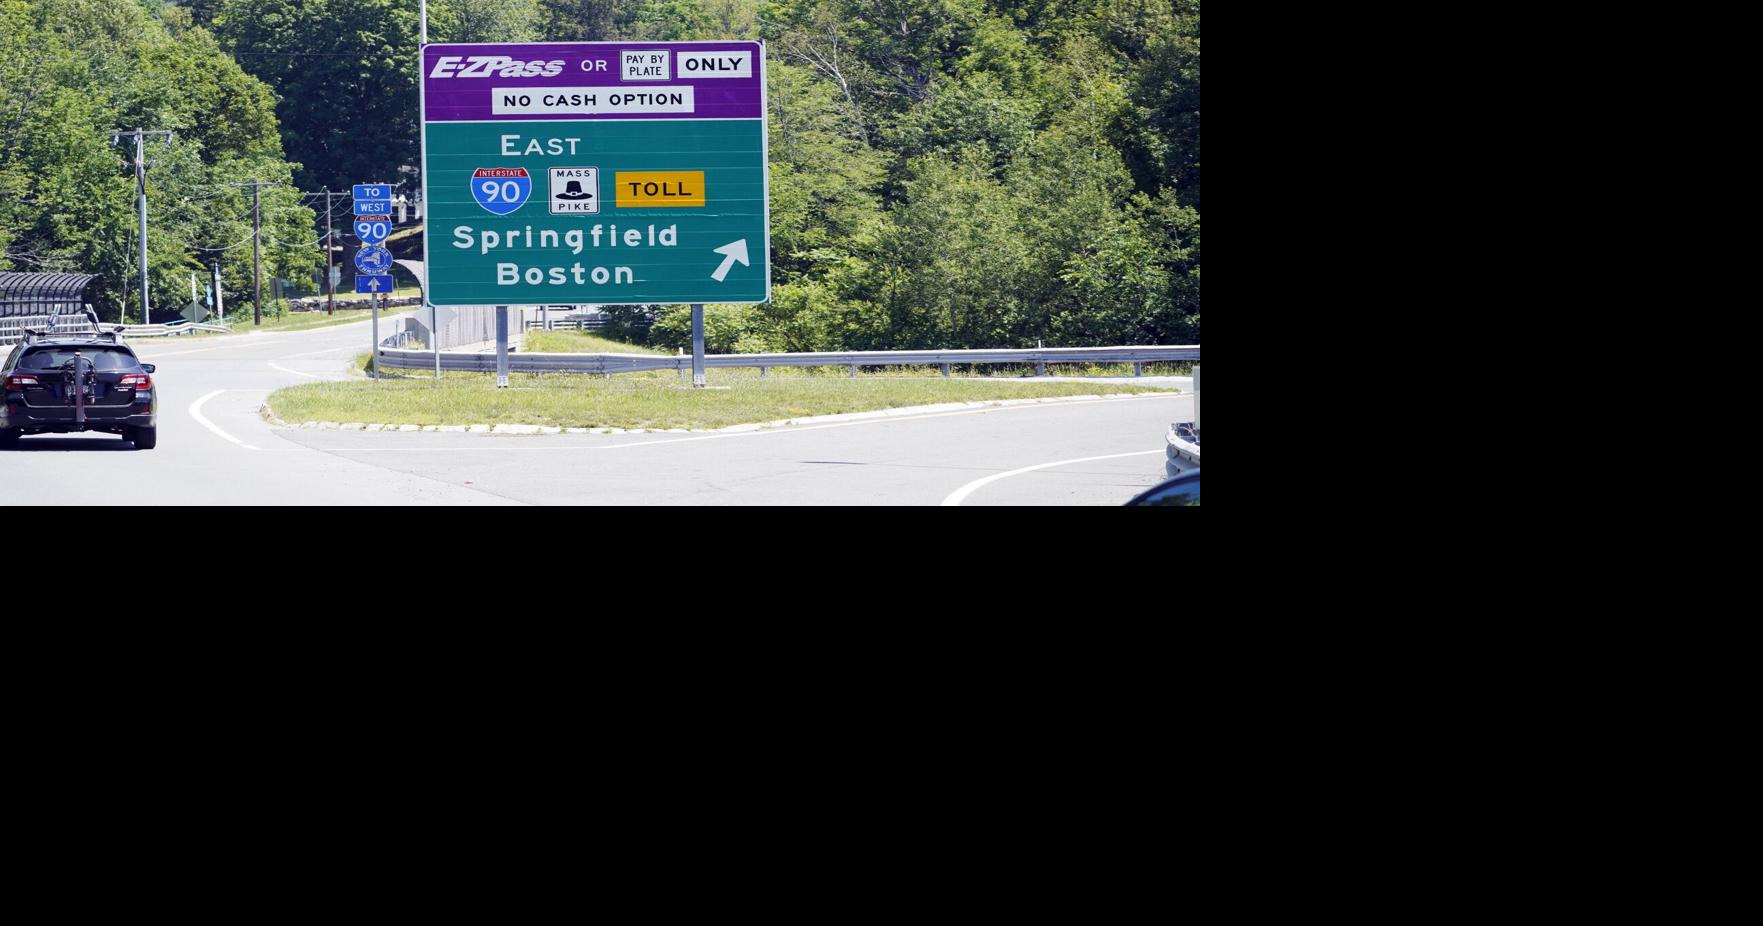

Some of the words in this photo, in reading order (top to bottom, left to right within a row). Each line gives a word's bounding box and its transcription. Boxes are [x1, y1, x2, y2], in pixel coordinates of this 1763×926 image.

[581, 59, 607, 72] OR
[626, 55, 645, 64] PAY
[650, 55, 664, 63] BY
[685, 57, 742, 72] ONLY
[629, 66, 662, 76] PLATE
[504, 95, 531, 107] NO
[543, 94, 596, 107] CASH
[609, 93, 683, 106] OPTION
[501, 134, 581, 156] EAST
[479, 169, 522, 177] INTERSTATE
[556, 169, 590, 178] MASS
[364, 187, 380, 197] TO
[481, 180, 520, 203] 90
[628, 182, 692, 196] TOLL
[360, 203, 385, 212] WEST
[558, 203, 590, 211] PIKE
[358, 222, 387, 239] 90
[452, 223, 678, 255] Springfield
[497, 262, 634, 285] Boston
